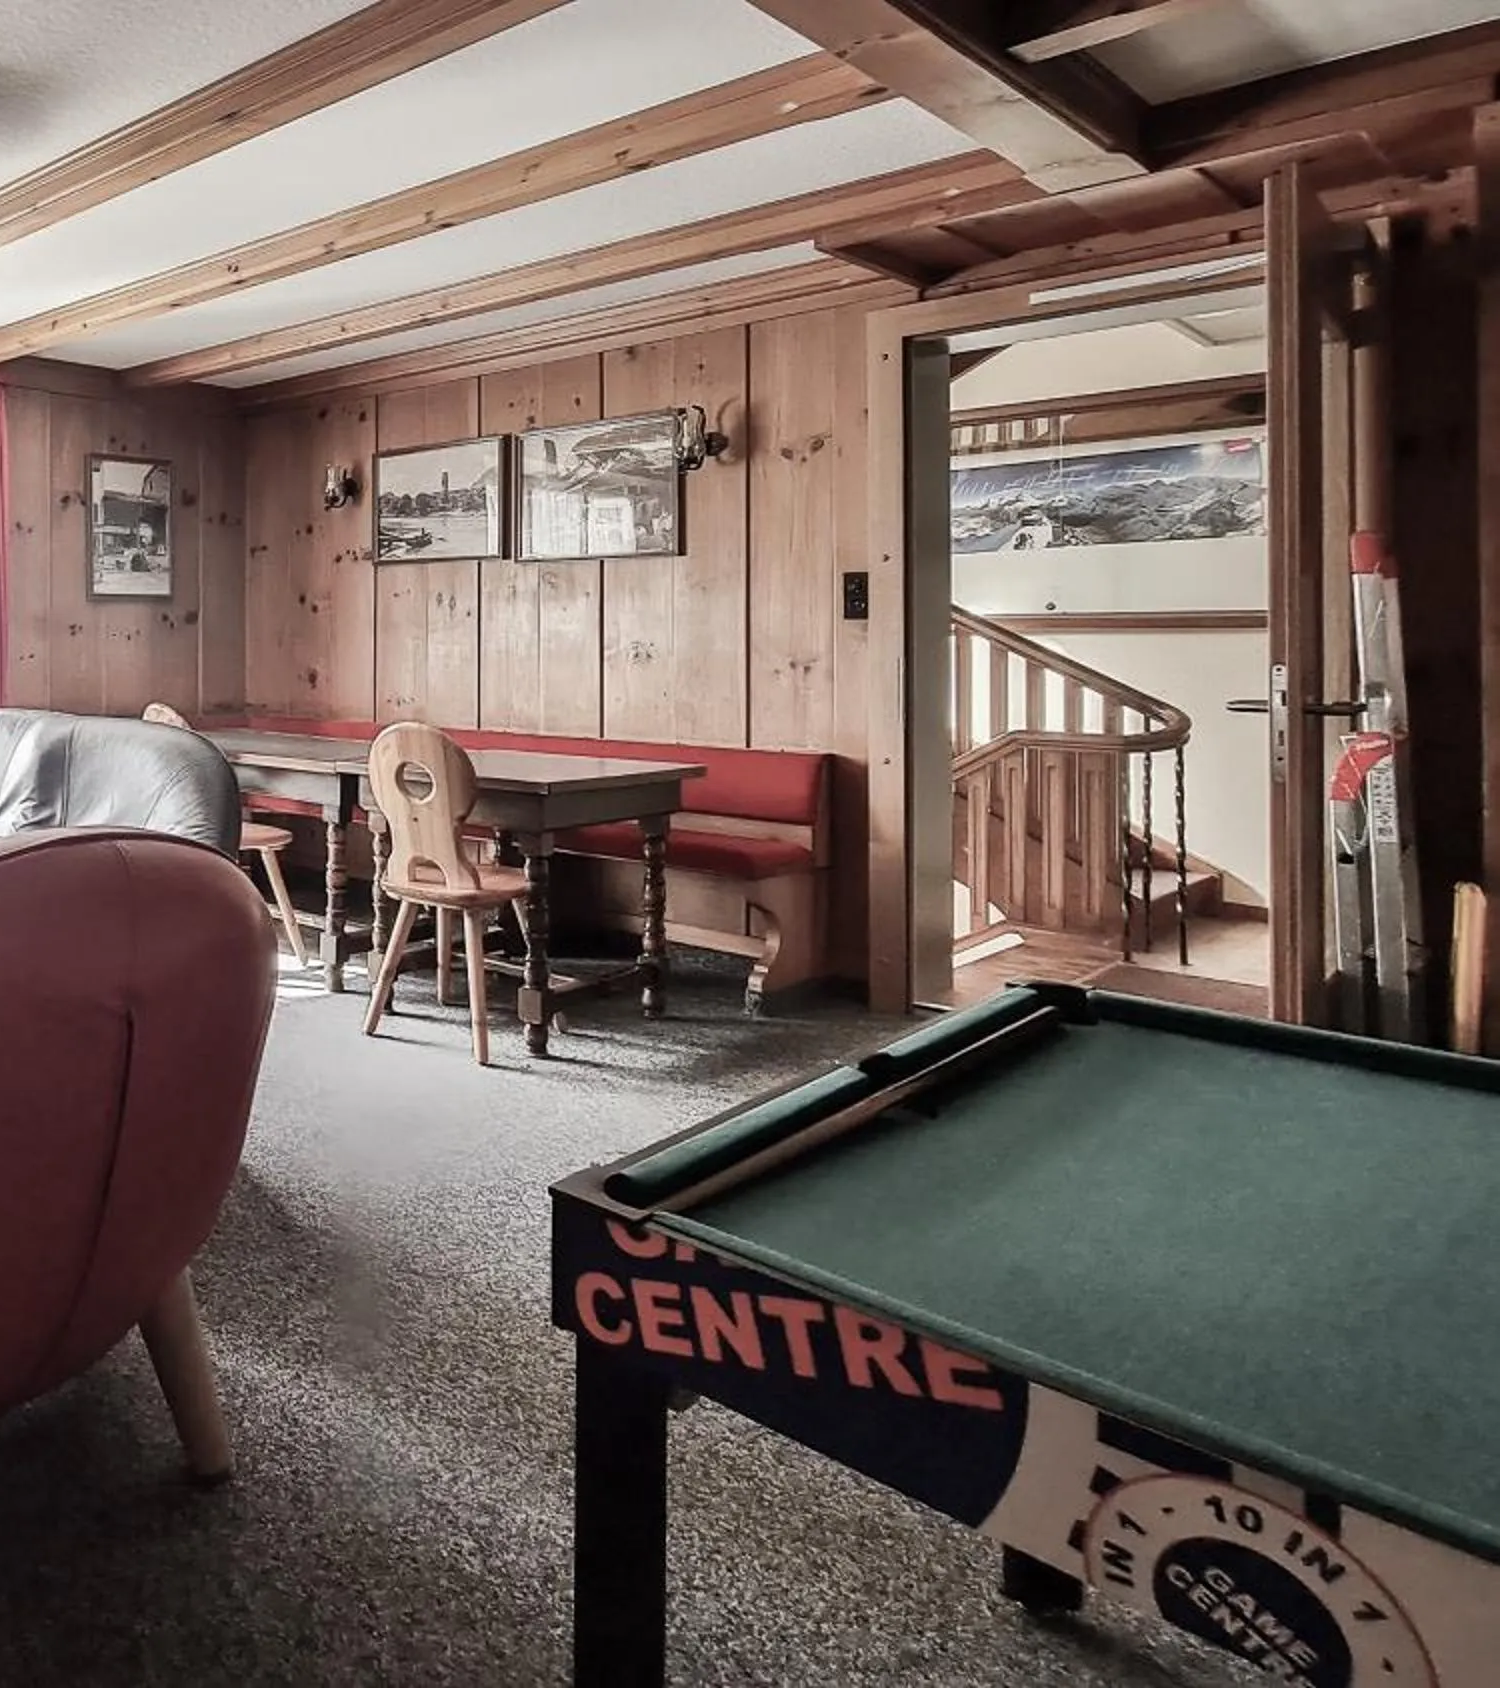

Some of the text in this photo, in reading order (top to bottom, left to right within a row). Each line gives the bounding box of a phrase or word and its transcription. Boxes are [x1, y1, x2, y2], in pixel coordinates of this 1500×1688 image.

[575, 1272, 1003, 1411] CENTRE
[1104, 1494, 1389, 1621] IN 1 10 IN 1
[1203, 1566, 1318, 1670] GAME
